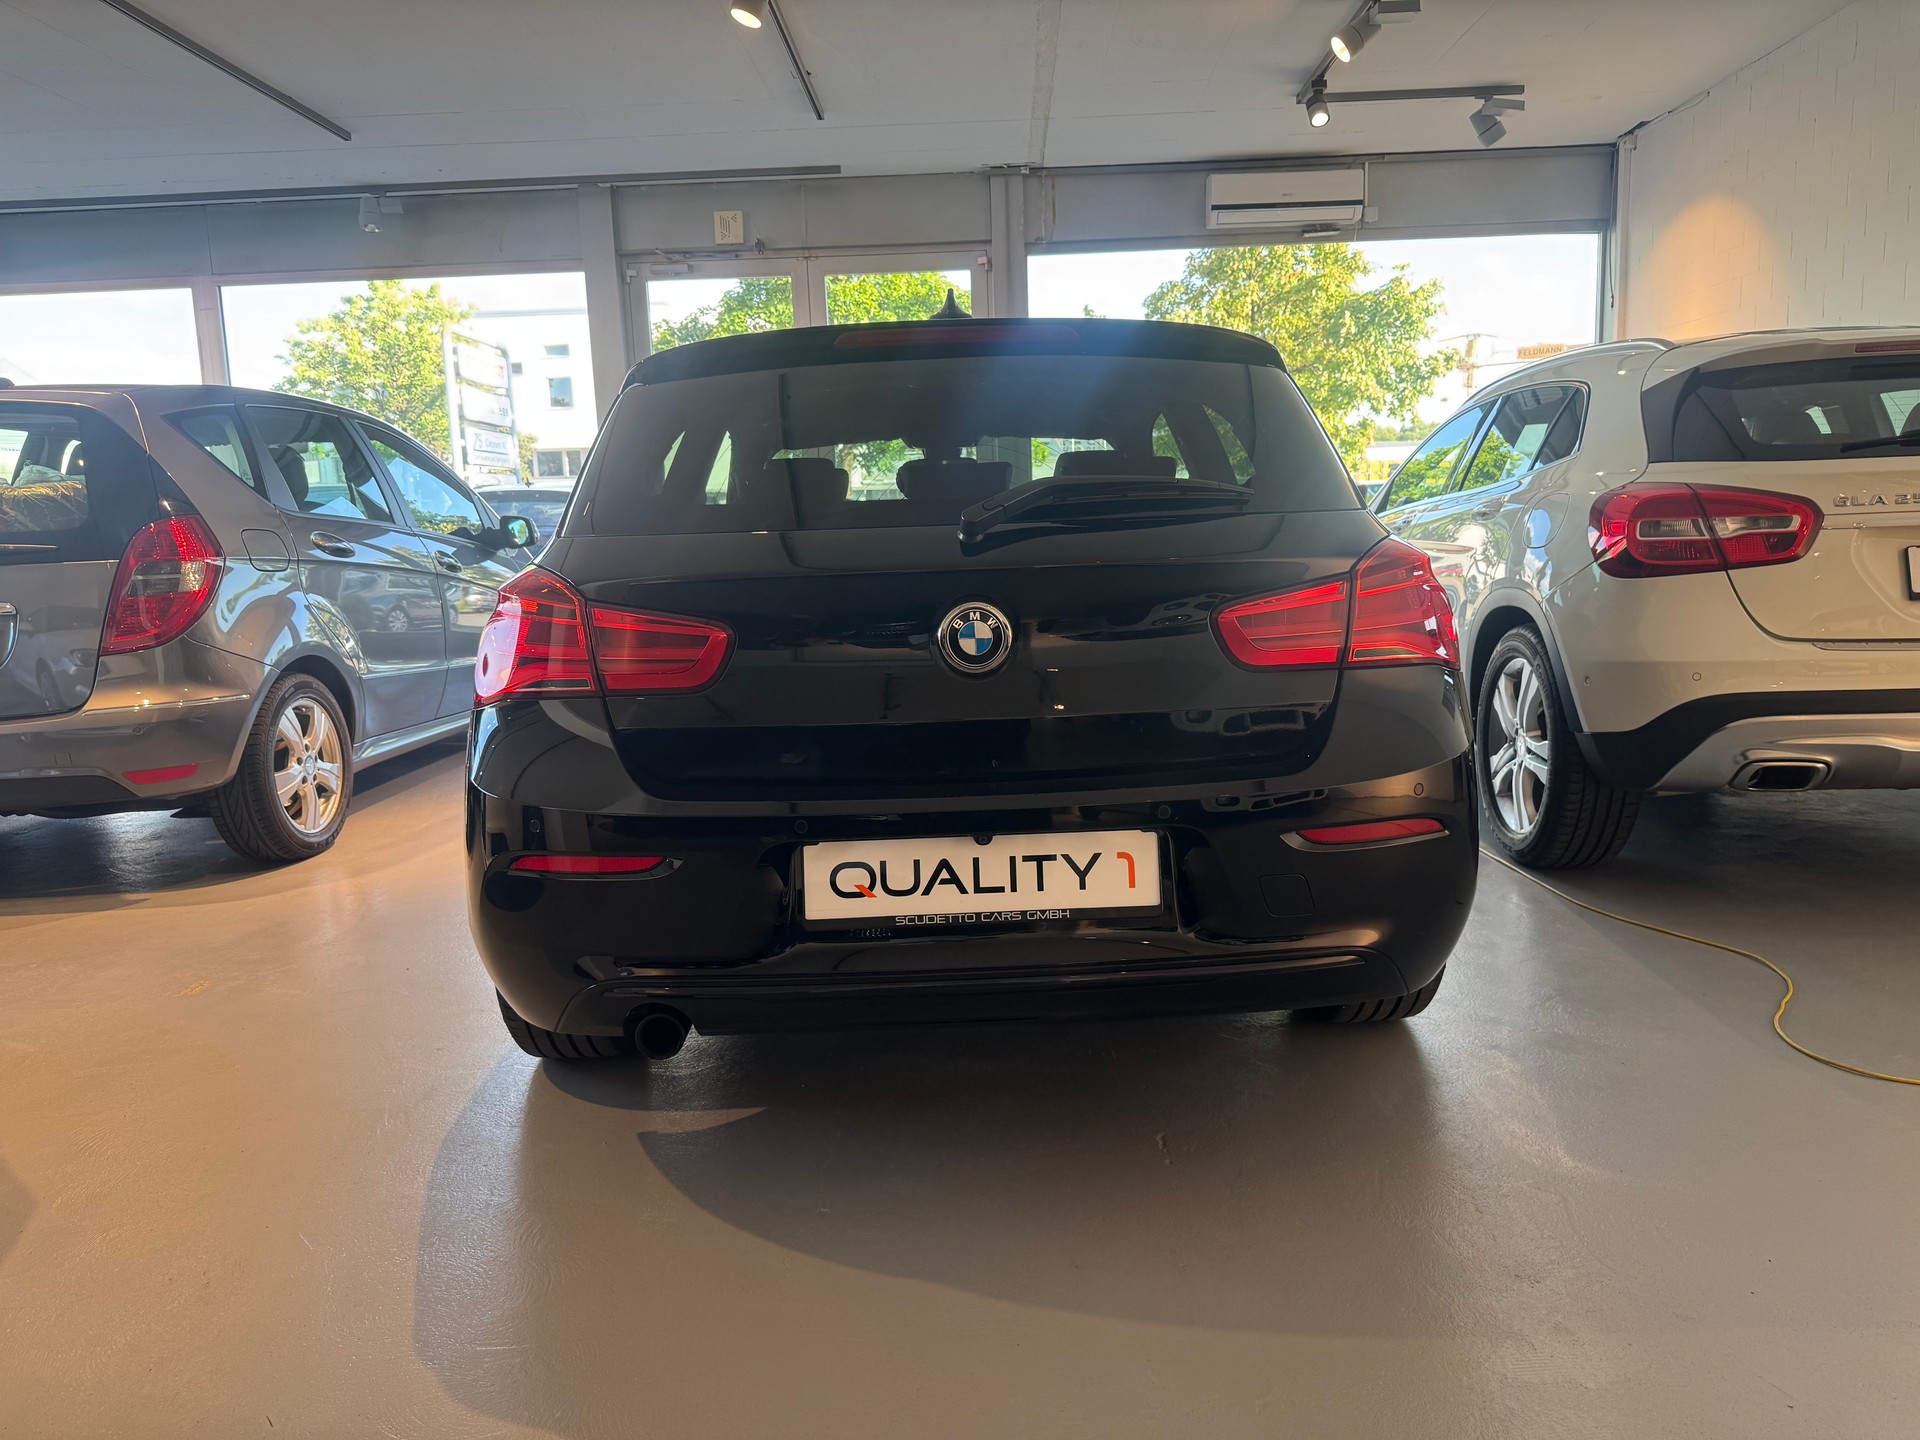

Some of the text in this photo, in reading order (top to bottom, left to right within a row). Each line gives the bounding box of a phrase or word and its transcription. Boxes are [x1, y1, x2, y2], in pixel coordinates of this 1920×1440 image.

[1518, 346, 1562, 357] FELDMANN
[1833, 494, 1889, 507] GLA
[952, 611, 999, 630] BMW
[829, 851, 1136, 899] QUALITY 1
[895, 909, 1070, 926] SCUDETTO CARS GMBH
